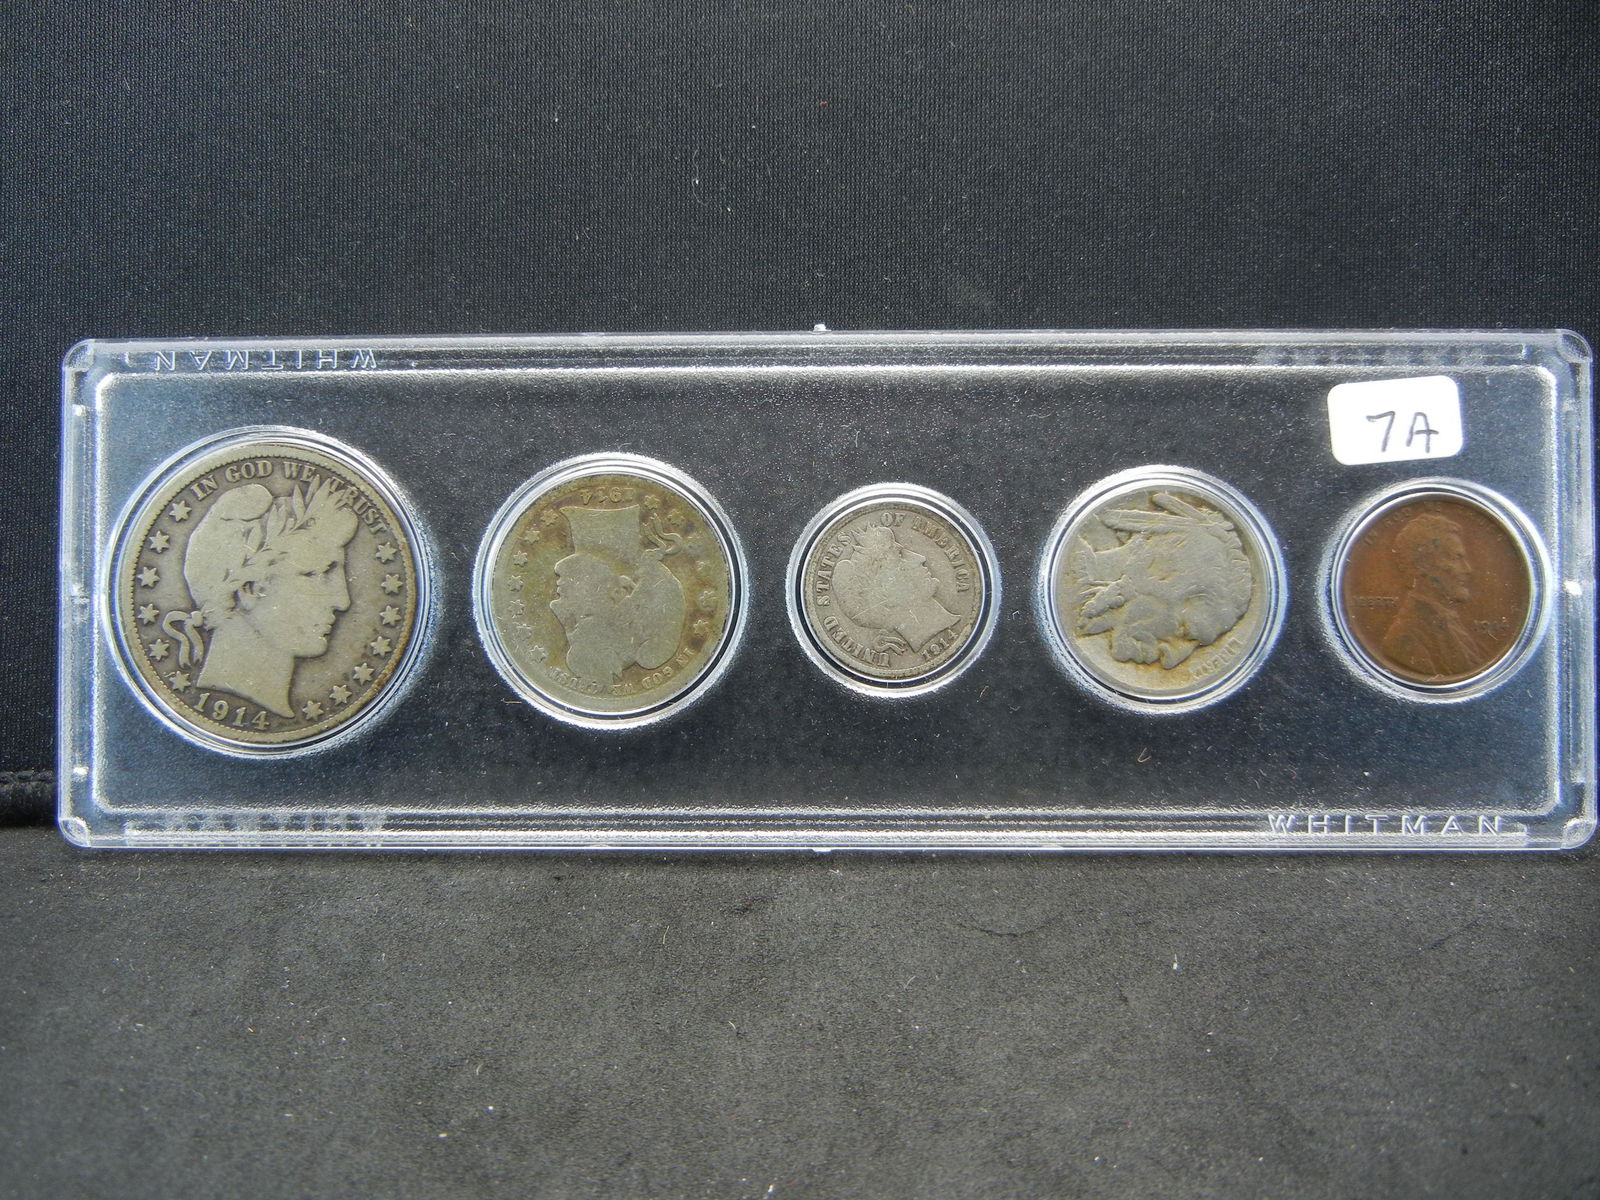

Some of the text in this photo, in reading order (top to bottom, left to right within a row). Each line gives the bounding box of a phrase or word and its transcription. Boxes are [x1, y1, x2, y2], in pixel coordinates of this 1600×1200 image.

[153, 346, 379, 371] WHITMAN
[1365, 410, 1440, 454] 7A
[190, 459, 390, 535] IN GOD WE TRUST
[816, 511, 971, 668] UNITED STATES OF AMERICA
[675, 647, 695, 665] IN
[919, 628, 960, 661] 1914
[641, 665, 674, 690] GOD
[196, 691, 271, 731] 1914
[1267, 813, 1503, 837] WHITMAN
